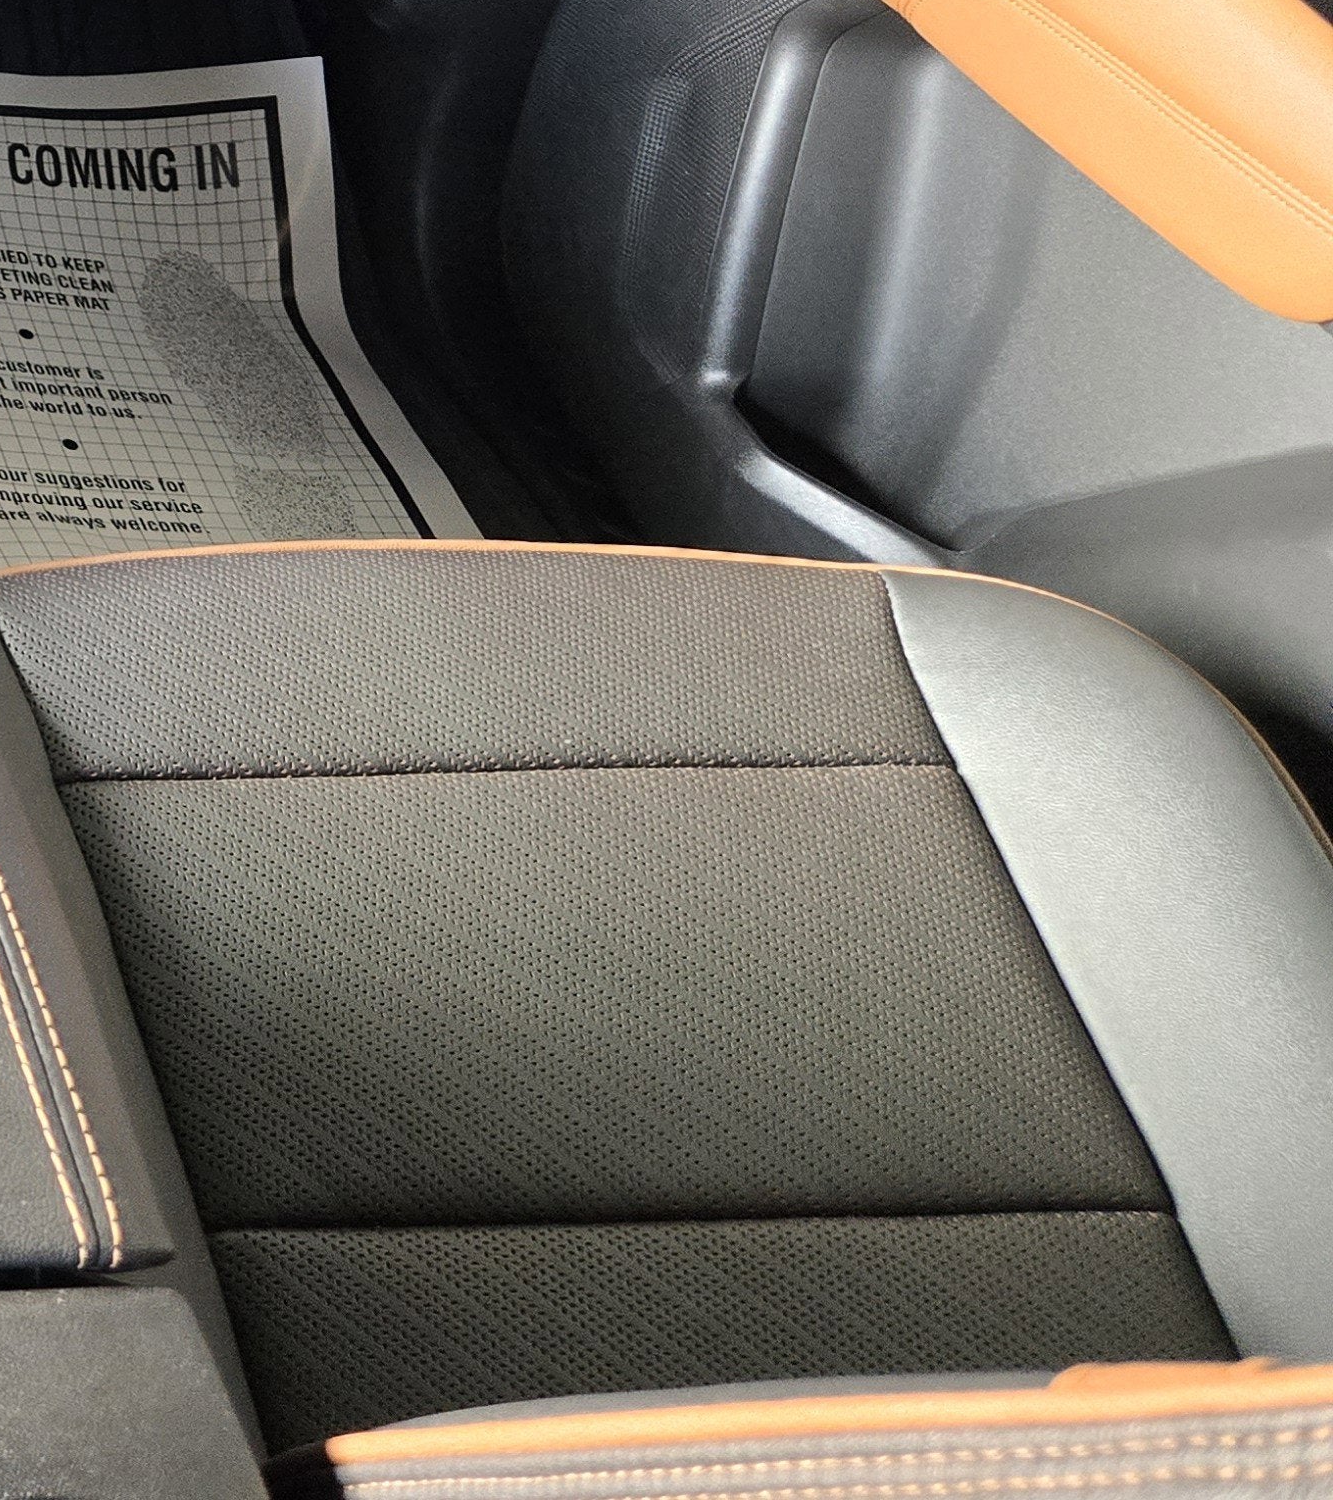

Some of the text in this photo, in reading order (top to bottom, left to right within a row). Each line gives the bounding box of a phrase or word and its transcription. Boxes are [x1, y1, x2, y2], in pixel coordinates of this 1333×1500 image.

[7, 142, 179, 193] COMING
[194, 141, 240, 190] IN
[32, 253, 58, 268] TO
[61, 256, 105, 274] KEEP
[57, 274, 116, 294] CLEAN
[11, 287, 70, 307] PAPER
[72, 295, 111, 311] MAT
[88, 366, 105, 381] is
[12, 376, 104, 399] important
[109, 388, 173, 405] person
[31, 400, 82, 416] world
[87, 403, 108, 417] to
[113, 407, 143, 420] us.
[34, 470, 154, 492] suggestions
[158, 477, 185, 493] for
[92, 496, 125, 510] our
[131, 498, 204, 514] service
[36, 510, 106, 530] always
[111, 518, 211, 534] welcome.
